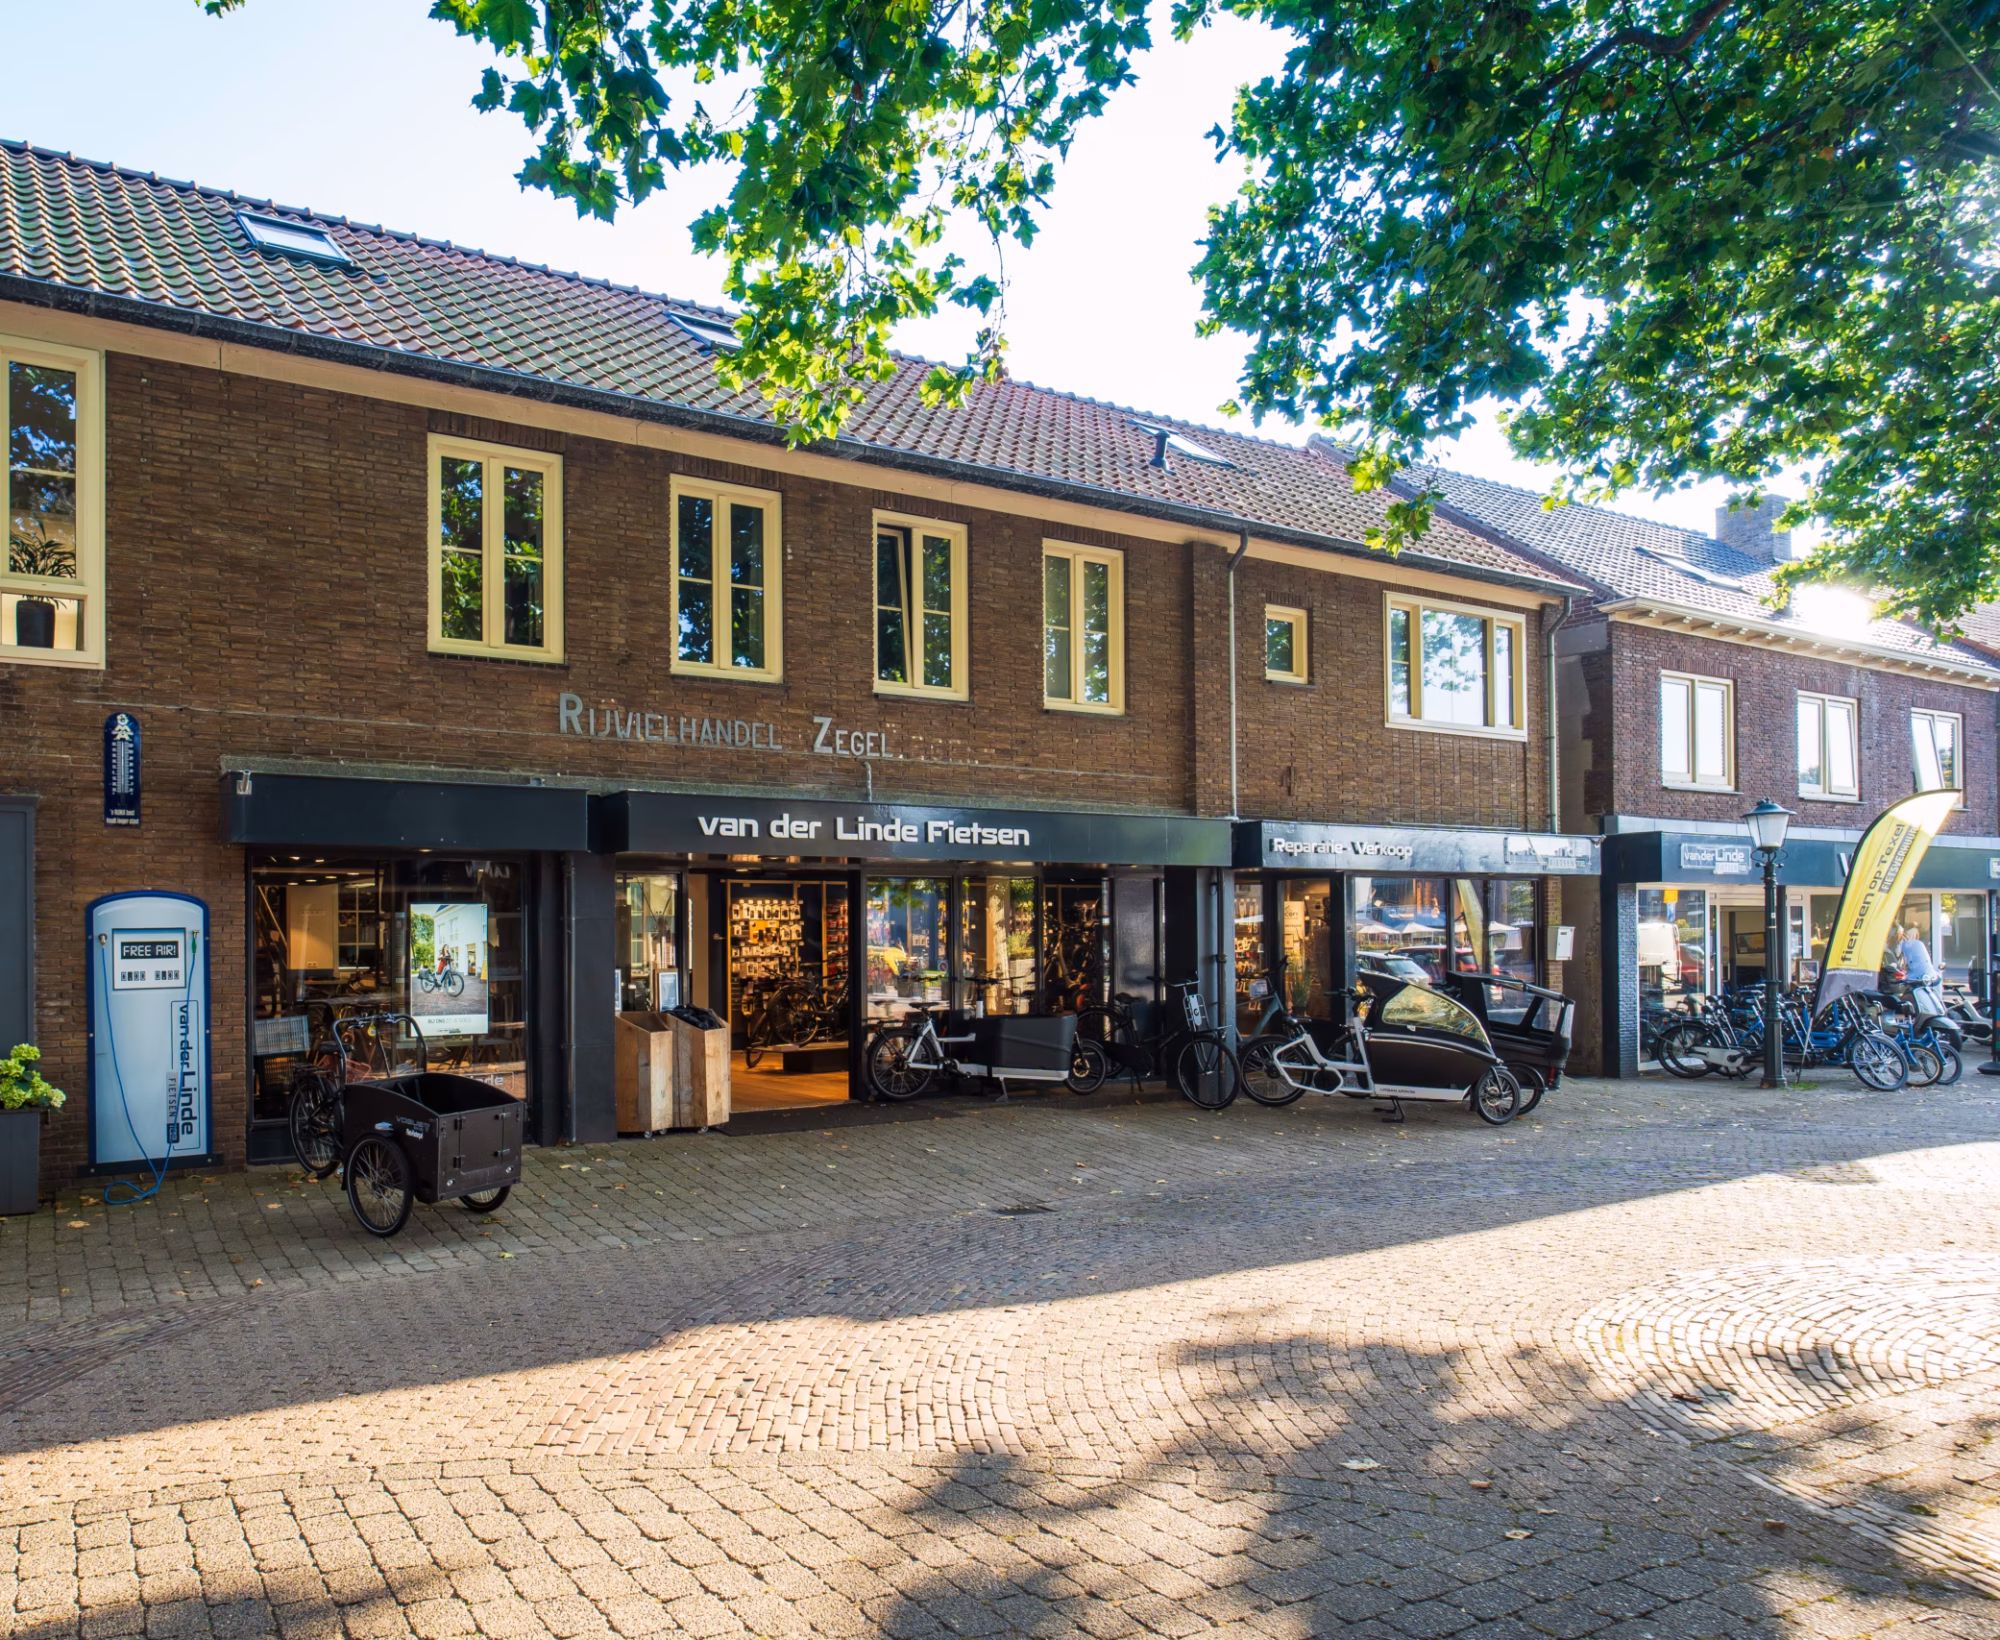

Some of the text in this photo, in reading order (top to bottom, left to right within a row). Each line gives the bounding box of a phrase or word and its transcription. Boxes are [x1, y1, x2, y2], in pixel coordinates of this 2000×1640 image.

[559, 692, 894, 758] RIJWIELHANDEL ZEGEL
[697, 813, 1030, 846] van der Linde Fietsen
[1355, 841, 1413, 860] Verkoop
[1840, 892, 1875, 963] fietsen
[1869, 868, 1883, 891] op
[1876, 823, 1906, 865] Texel
[122, 944, 176, 957] FREE AIR!
[168, 1078, 177, 1118] FIETSEN
[180, 1071, 198, 1135] Linde
